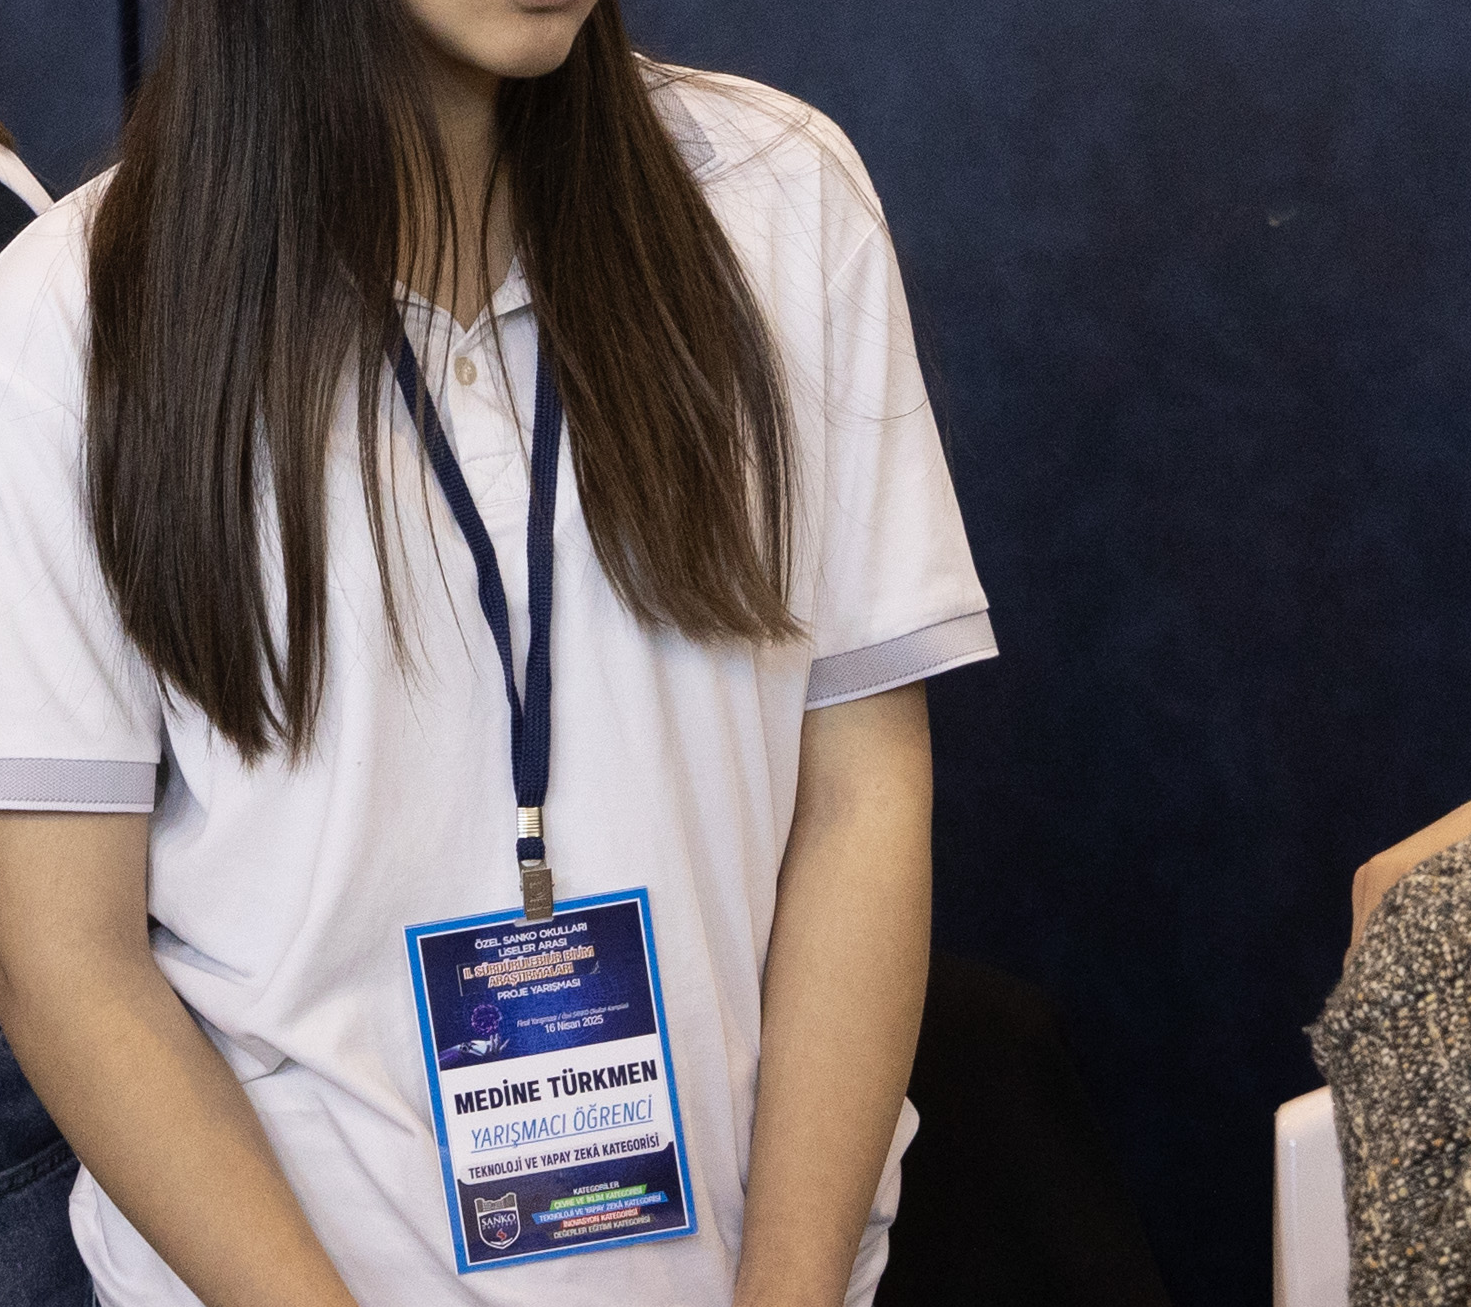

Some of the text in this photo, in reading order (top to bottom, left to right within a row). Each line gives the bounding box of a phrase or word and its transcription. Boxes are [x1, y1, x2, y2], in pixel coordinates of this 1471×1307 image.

[503, 931, 537, 945] SANKO
[539, 922, 588, 938] OKULLARI
[538, 938, 568, 950] ARASI
[497, 987, 529, 1001] PROJE
[544, 1014, 604, 1034] 16 Nisan 2025
[454, 1059, 659, 1115] MEDİNE TÜRKMEN
[471, 1094, 653, 1147] YARIŞMACI ÖĞRENCİ
[469, 1132, 660, 1180] TEKNOLOJİ VE YAPAY ZEKÂ KATEGORİSİ
